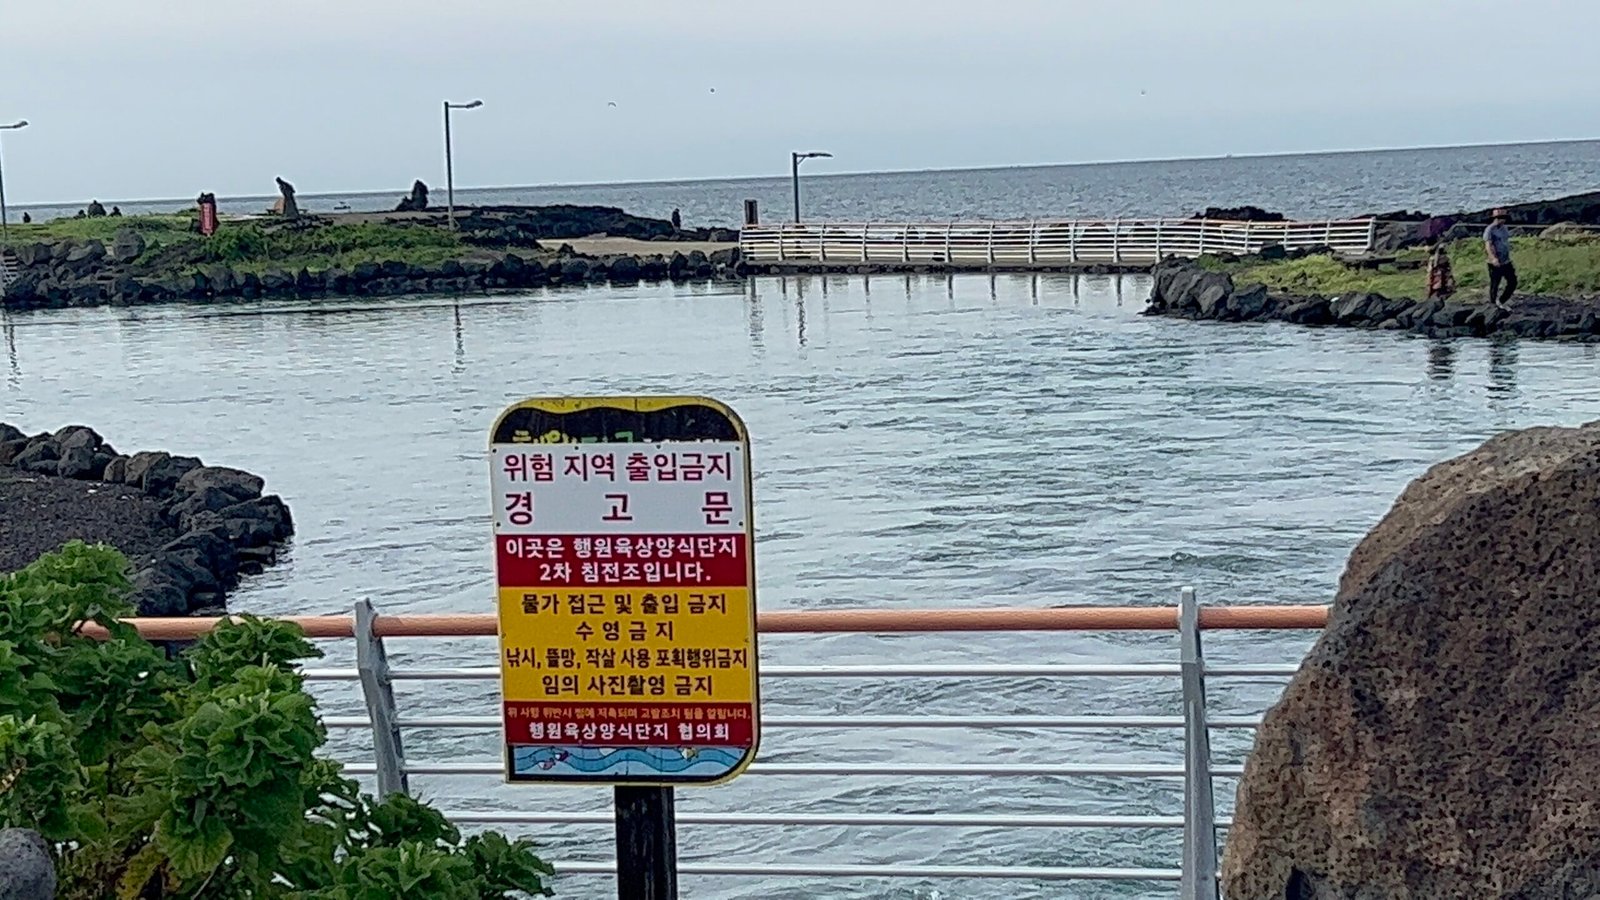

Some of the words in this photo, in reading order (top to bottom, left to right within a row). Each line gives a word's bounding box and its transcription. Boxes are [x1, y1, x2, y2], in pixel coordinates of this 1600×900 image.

[504, 453, 554, 482] 위험
[563, 453, 616, 482] 지역
[626, 452, 732, 482] 출입금지
[505, 491, 534, 525] 경
[602, 493, 633, 522] 고
[701, 491, 733, 525] 문
[505, 537, 566, 559] 이곳은
[573, 537, 738, 558] 행원육상양식단지
[539, 563, 572, 582] 2차
[581, 562, 712, 583] 침전조입니다.
[521, 594, 560, 614] 물가
[567, 594, 606, 614] 접근
[614, 594, 632, 614] 및
[640, 593, 679, 614] 출입
[687, 593, 726, 614] 금지
[506, 648, 541, 669] 낚시,
[585, 648, 616, 669] 작살
[620, 648, 651, 668] 사용
[655, 648, 748, 668] 포획행위금지
[542, 675, 579, 695] 임의
[587, 675, 665, 695] 사진촬영
[674, 675, 713, 695] 금지
[529, 721, 669, 740] 행원육상양식단지
[678, 722, 730, 741] 협의회
